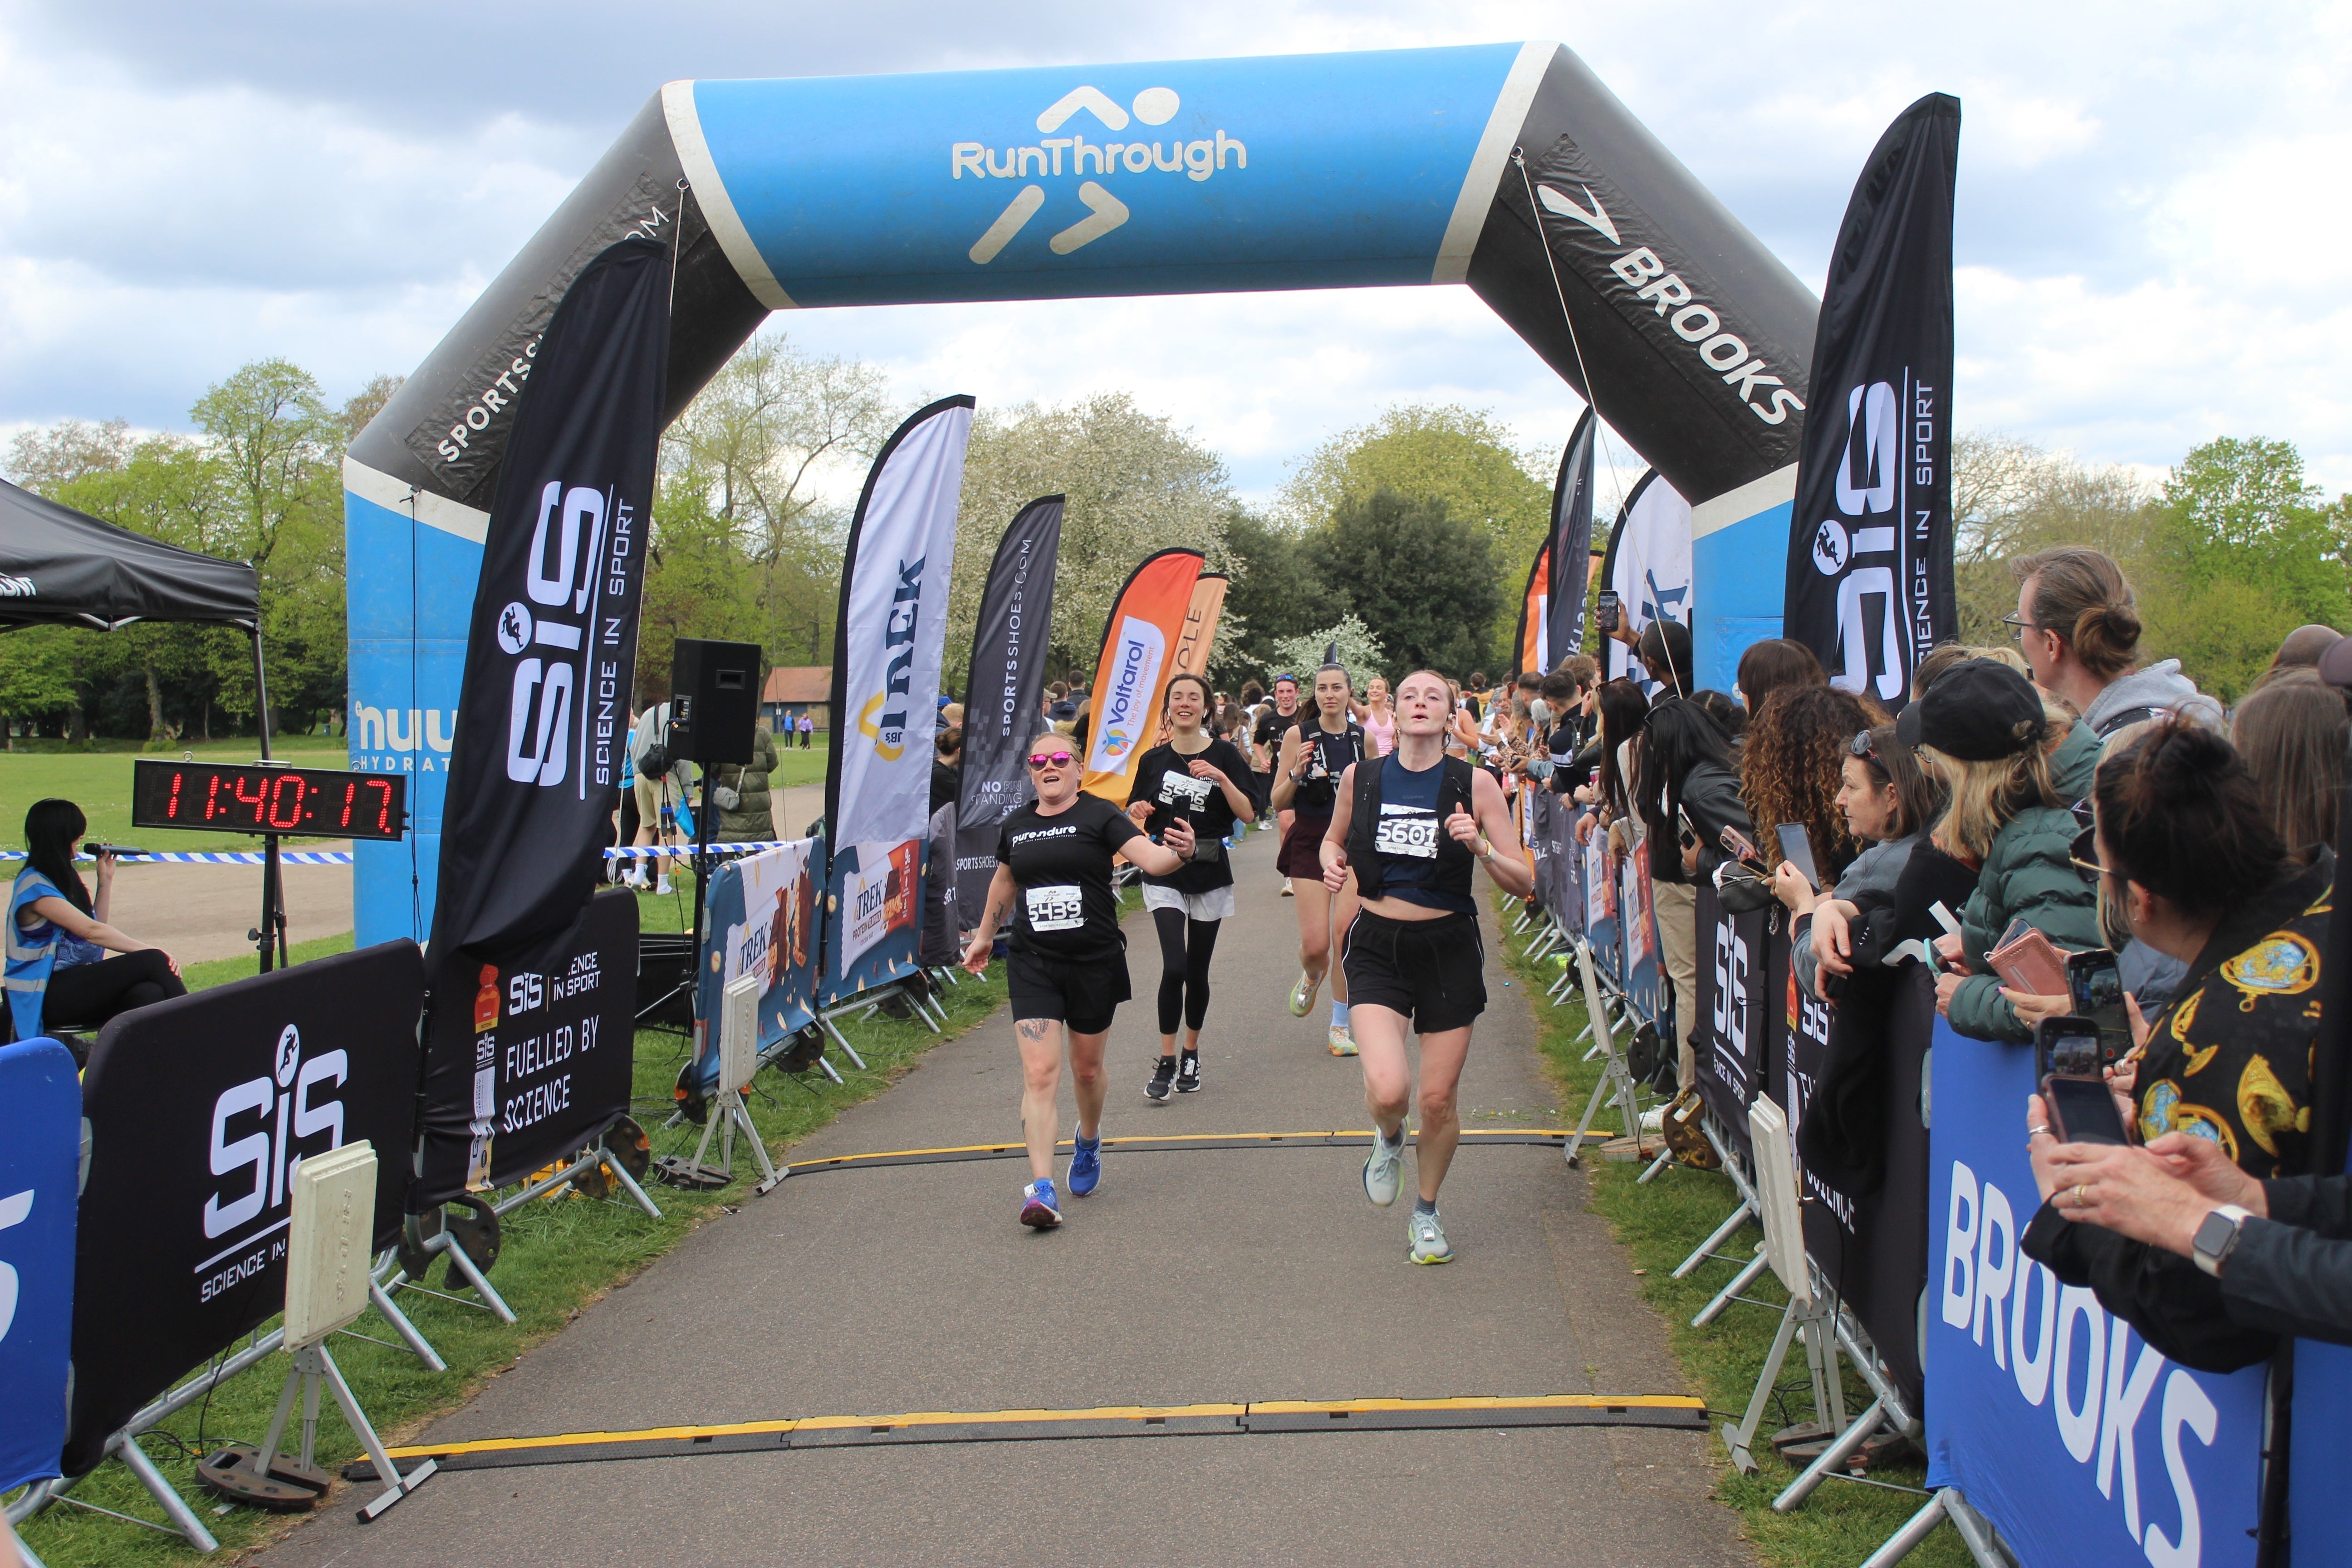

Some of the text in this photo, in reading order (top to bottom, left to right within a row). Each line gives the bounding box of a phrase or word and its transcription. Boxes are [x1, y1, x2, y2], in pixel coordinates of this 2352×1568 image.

[953, 129, 1246, 181] RunThrough
[1609, 246, 1806, 425] BROOKS
[1916, 379, 1933, 485] SPORT
[1916, 510, 1930, 539] IN
[597, 498, 633, 785] SCIENCE IN SPORT
[1002, 539, 1032, 736] SPORTSSHOES.COM
[1107, 640, 1145, 725] Voltarol
[1127, 647, 1155, 727] The joy of movement
[355, 701, 458, 753] nuu
[361, 756, 451, 771] HYDRAT
[981, 780, 1021, 793] NO FUN
[970, 793, 1022, 806] STANDING
[1376, 821, 1436, 848] 5601
[956, 856, 999, 871] SPORTSSHOES.
[857, 879, 882, 921] TREK
[1029, 901, 1081, 922] 5439
[740, 921, 768, 975] TREK
[853, 920, 868, 941] PROTEIN
[554, 970, 601, 1001] IN SPORT
[506, 1015, 599, 1083] FUELLED BY
[503, 1074, 571, 1133] SCIENCE
[1726, 1069, 1732, 1088] IN
[201, 1238, 286, 1303] SCIENCE IN
